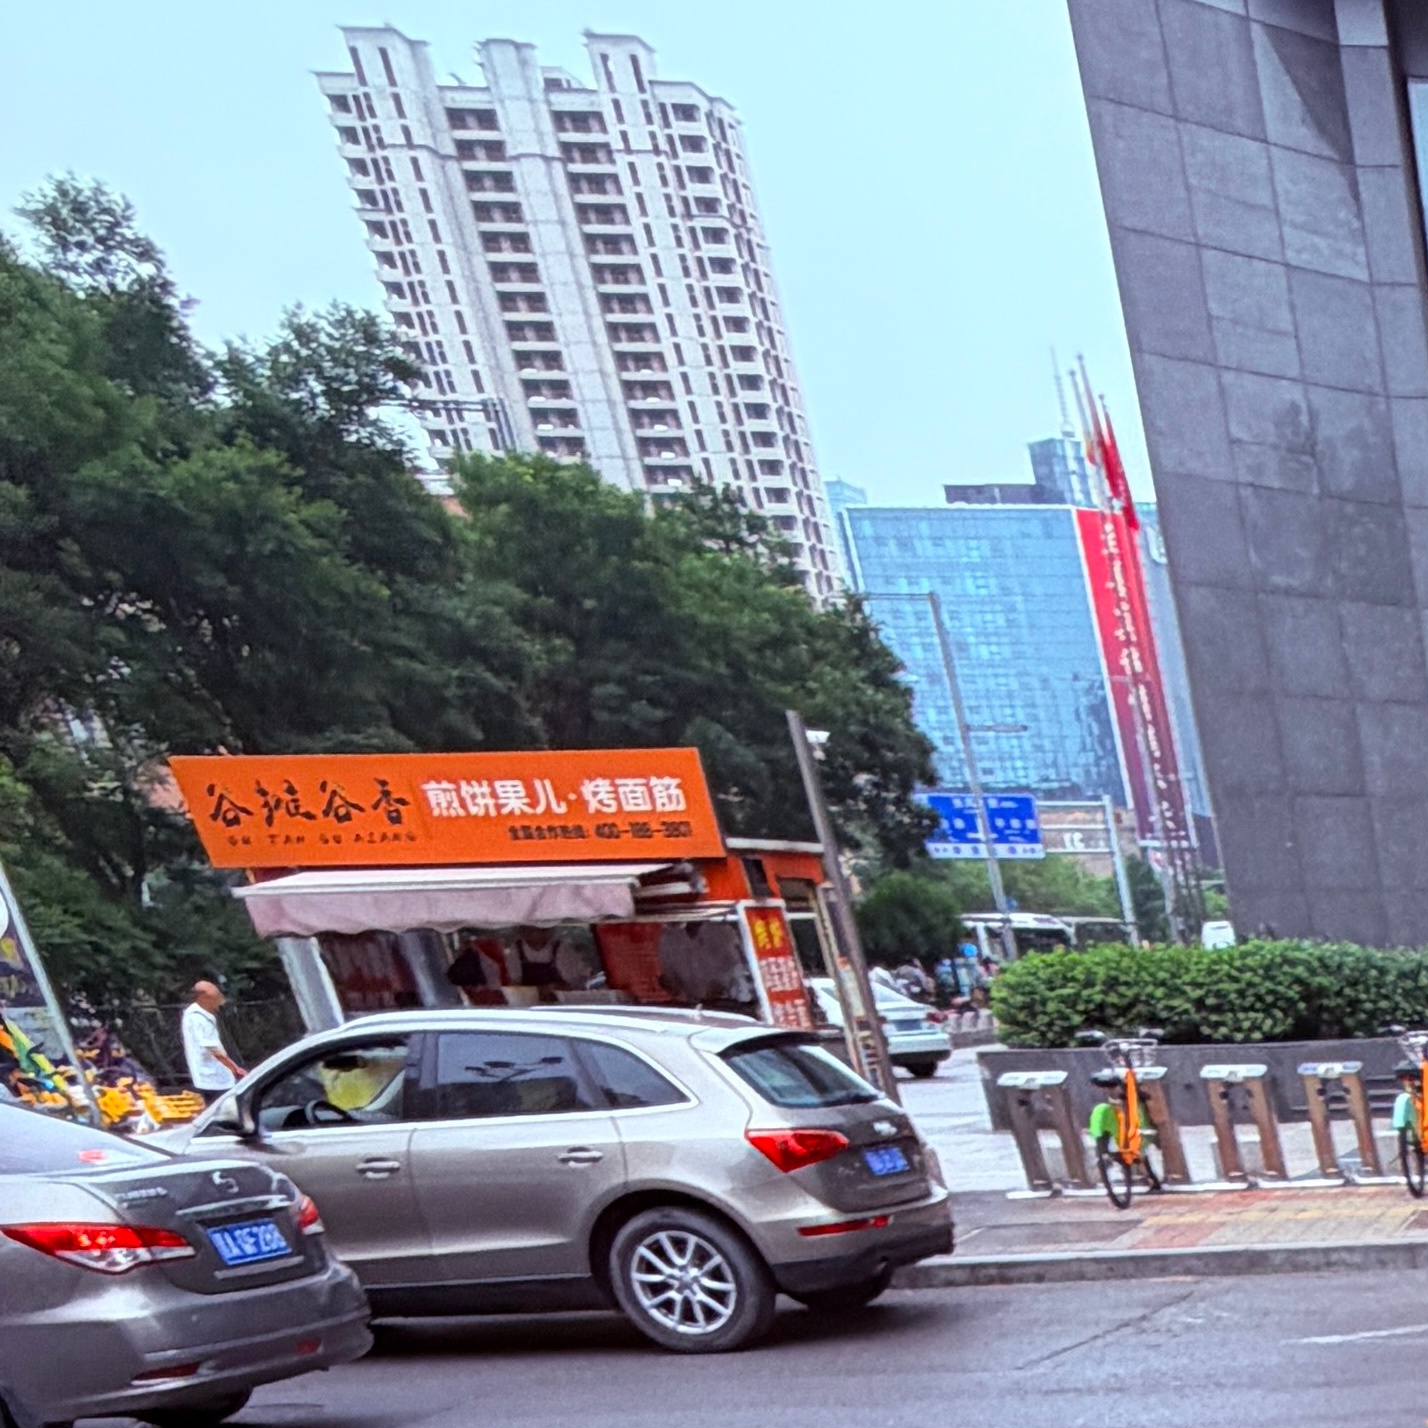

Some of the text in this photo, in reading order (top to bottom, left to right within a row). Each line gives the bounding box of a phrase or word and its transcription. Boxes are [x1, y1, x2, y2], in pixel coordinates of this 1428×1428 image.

[421, 776, 687, 818] 煎饼果儿·烤面筋
